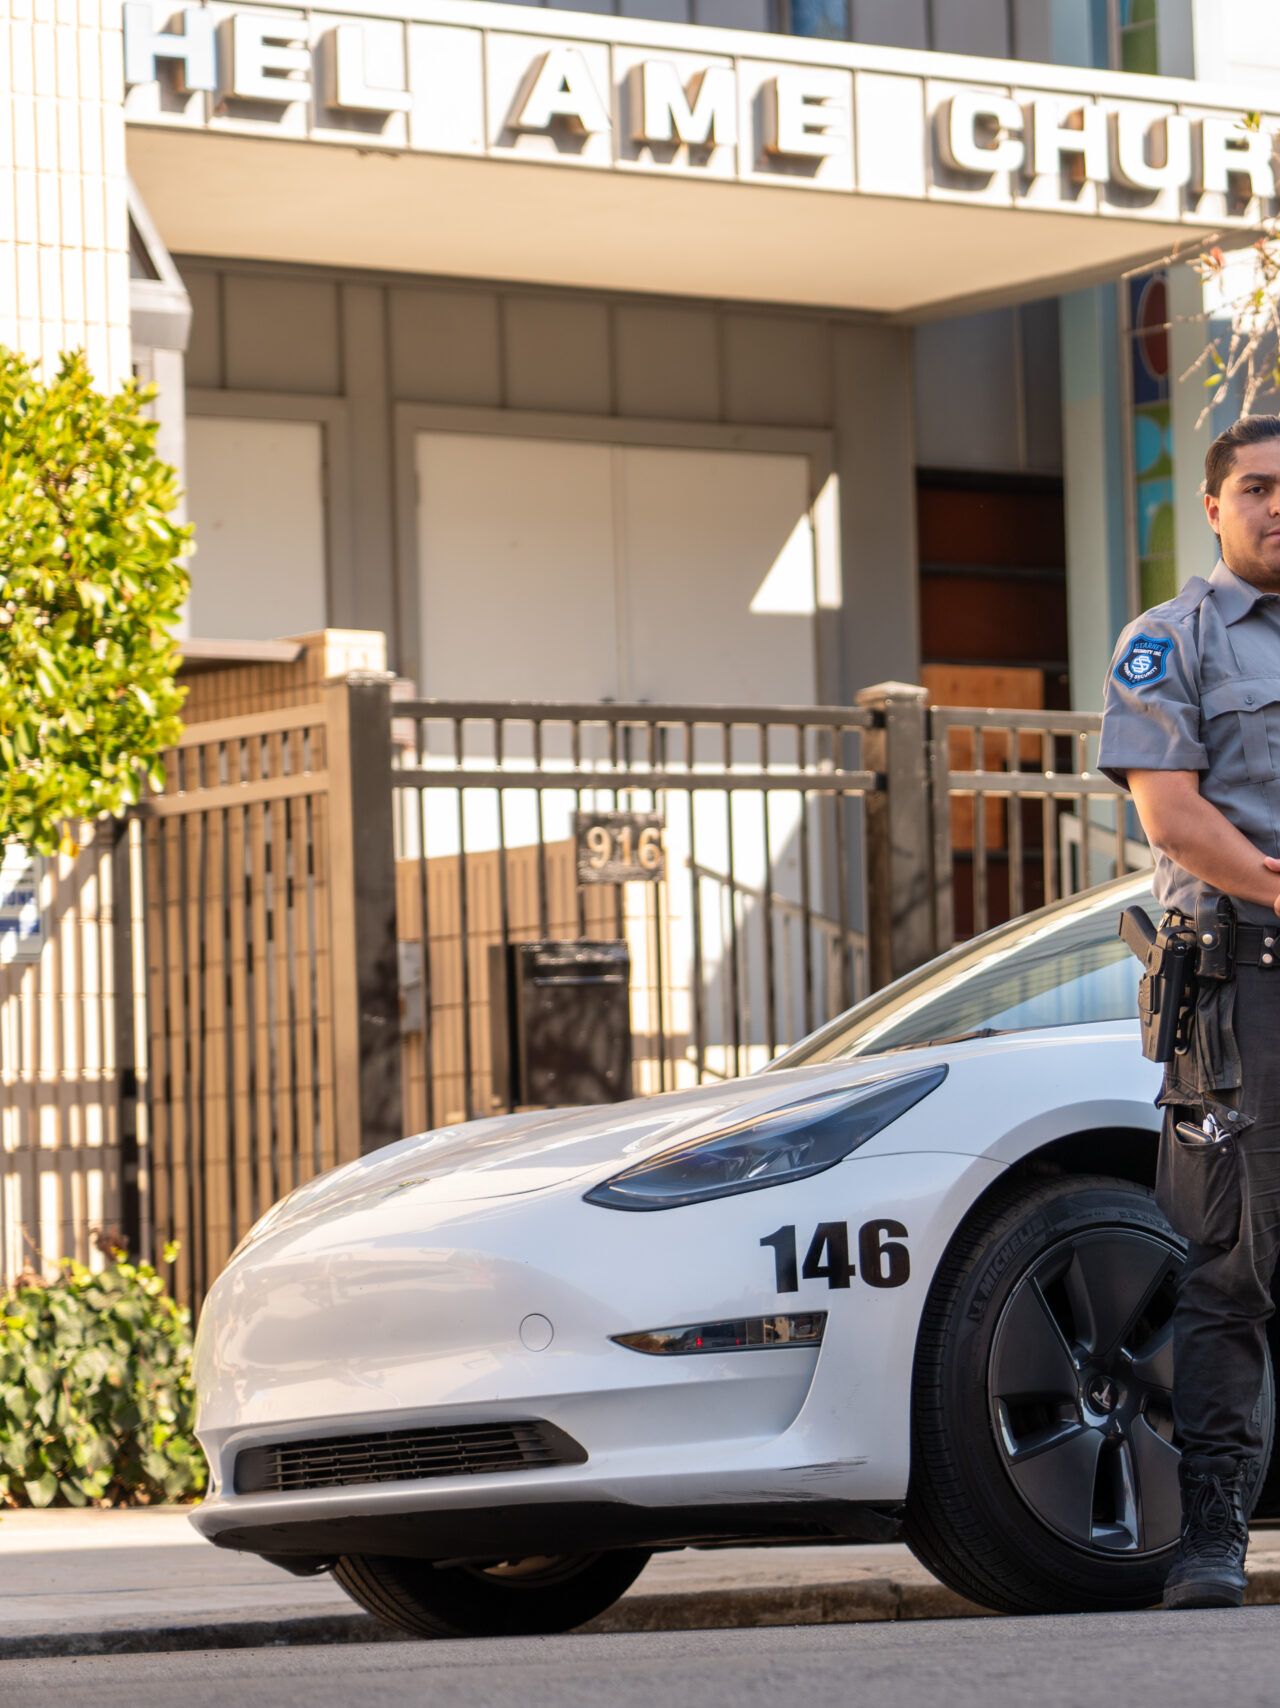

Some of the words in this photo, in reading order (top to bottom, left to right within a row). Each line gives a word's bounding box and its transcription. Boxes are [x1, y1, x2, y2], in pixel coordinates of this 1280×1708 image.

[515, 46, 849, 158] AME
[586, 826, 661, 870] 916
[759, 1218, 911, 1294] 146
[979, 1214, 1046, 1297] MICHELIN
